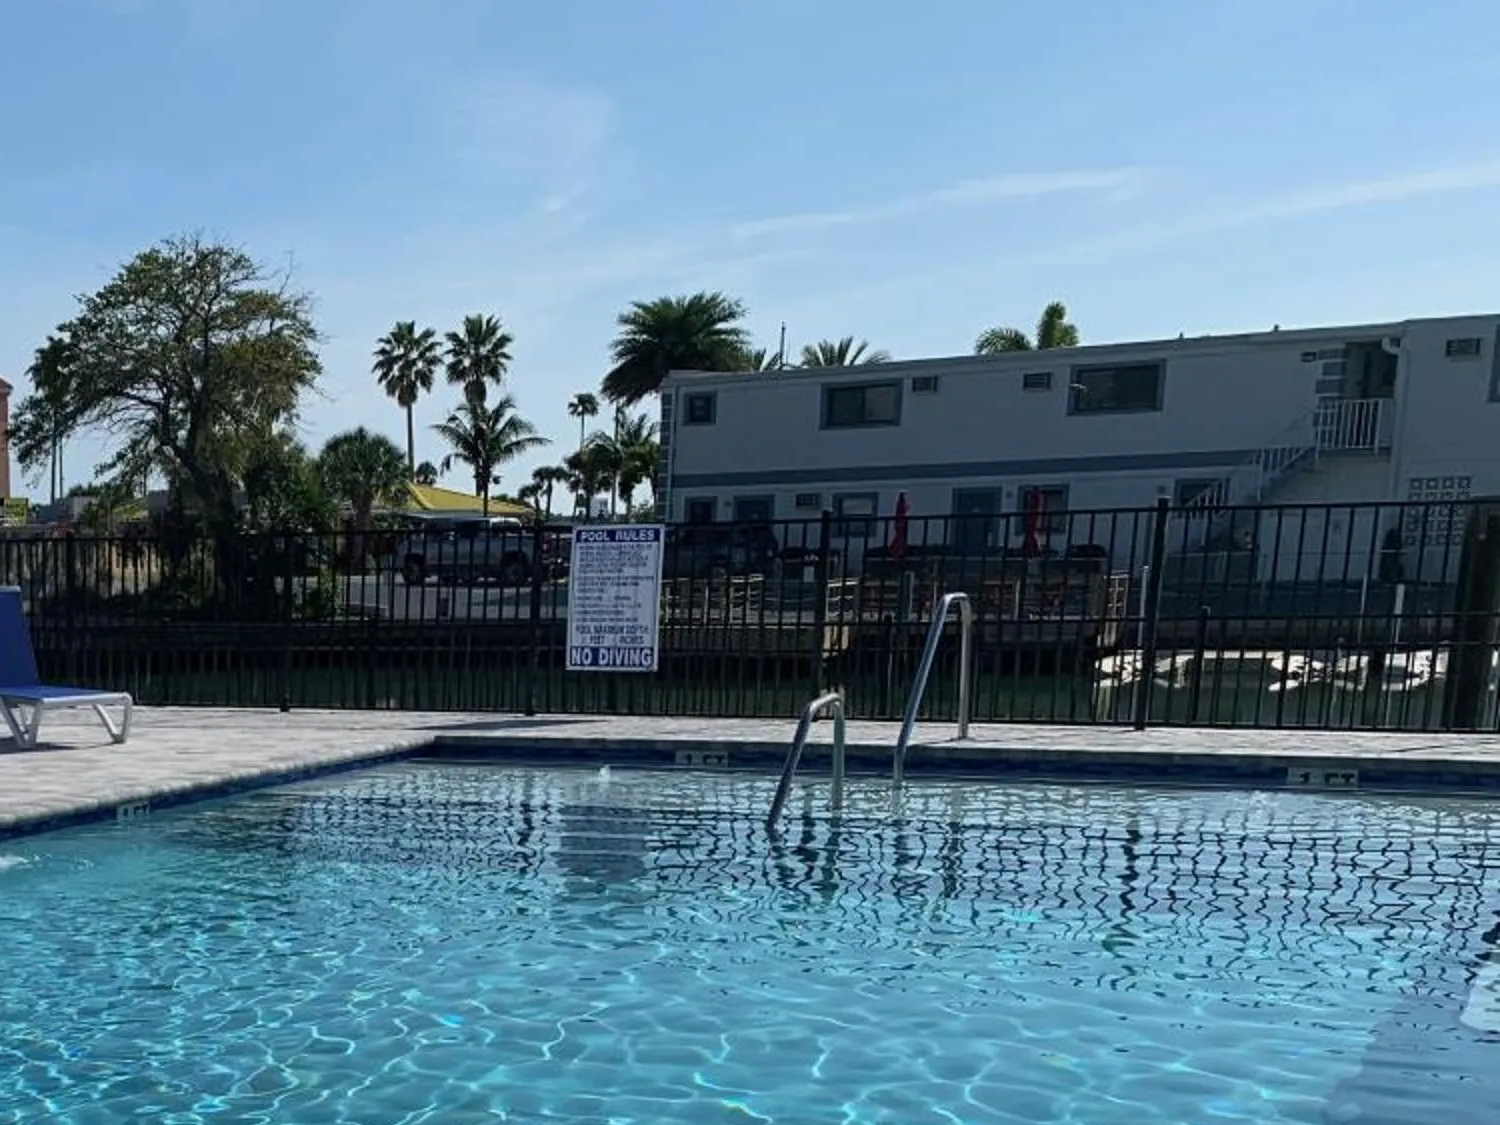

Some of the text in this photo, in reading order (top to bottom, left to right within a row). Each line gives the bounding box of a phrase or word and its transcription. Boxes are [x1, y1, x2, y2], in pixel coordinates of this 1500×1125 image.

[580, 529, 655, 541] POOL RULES
[571, 647, 653, 667] NO DIVING
